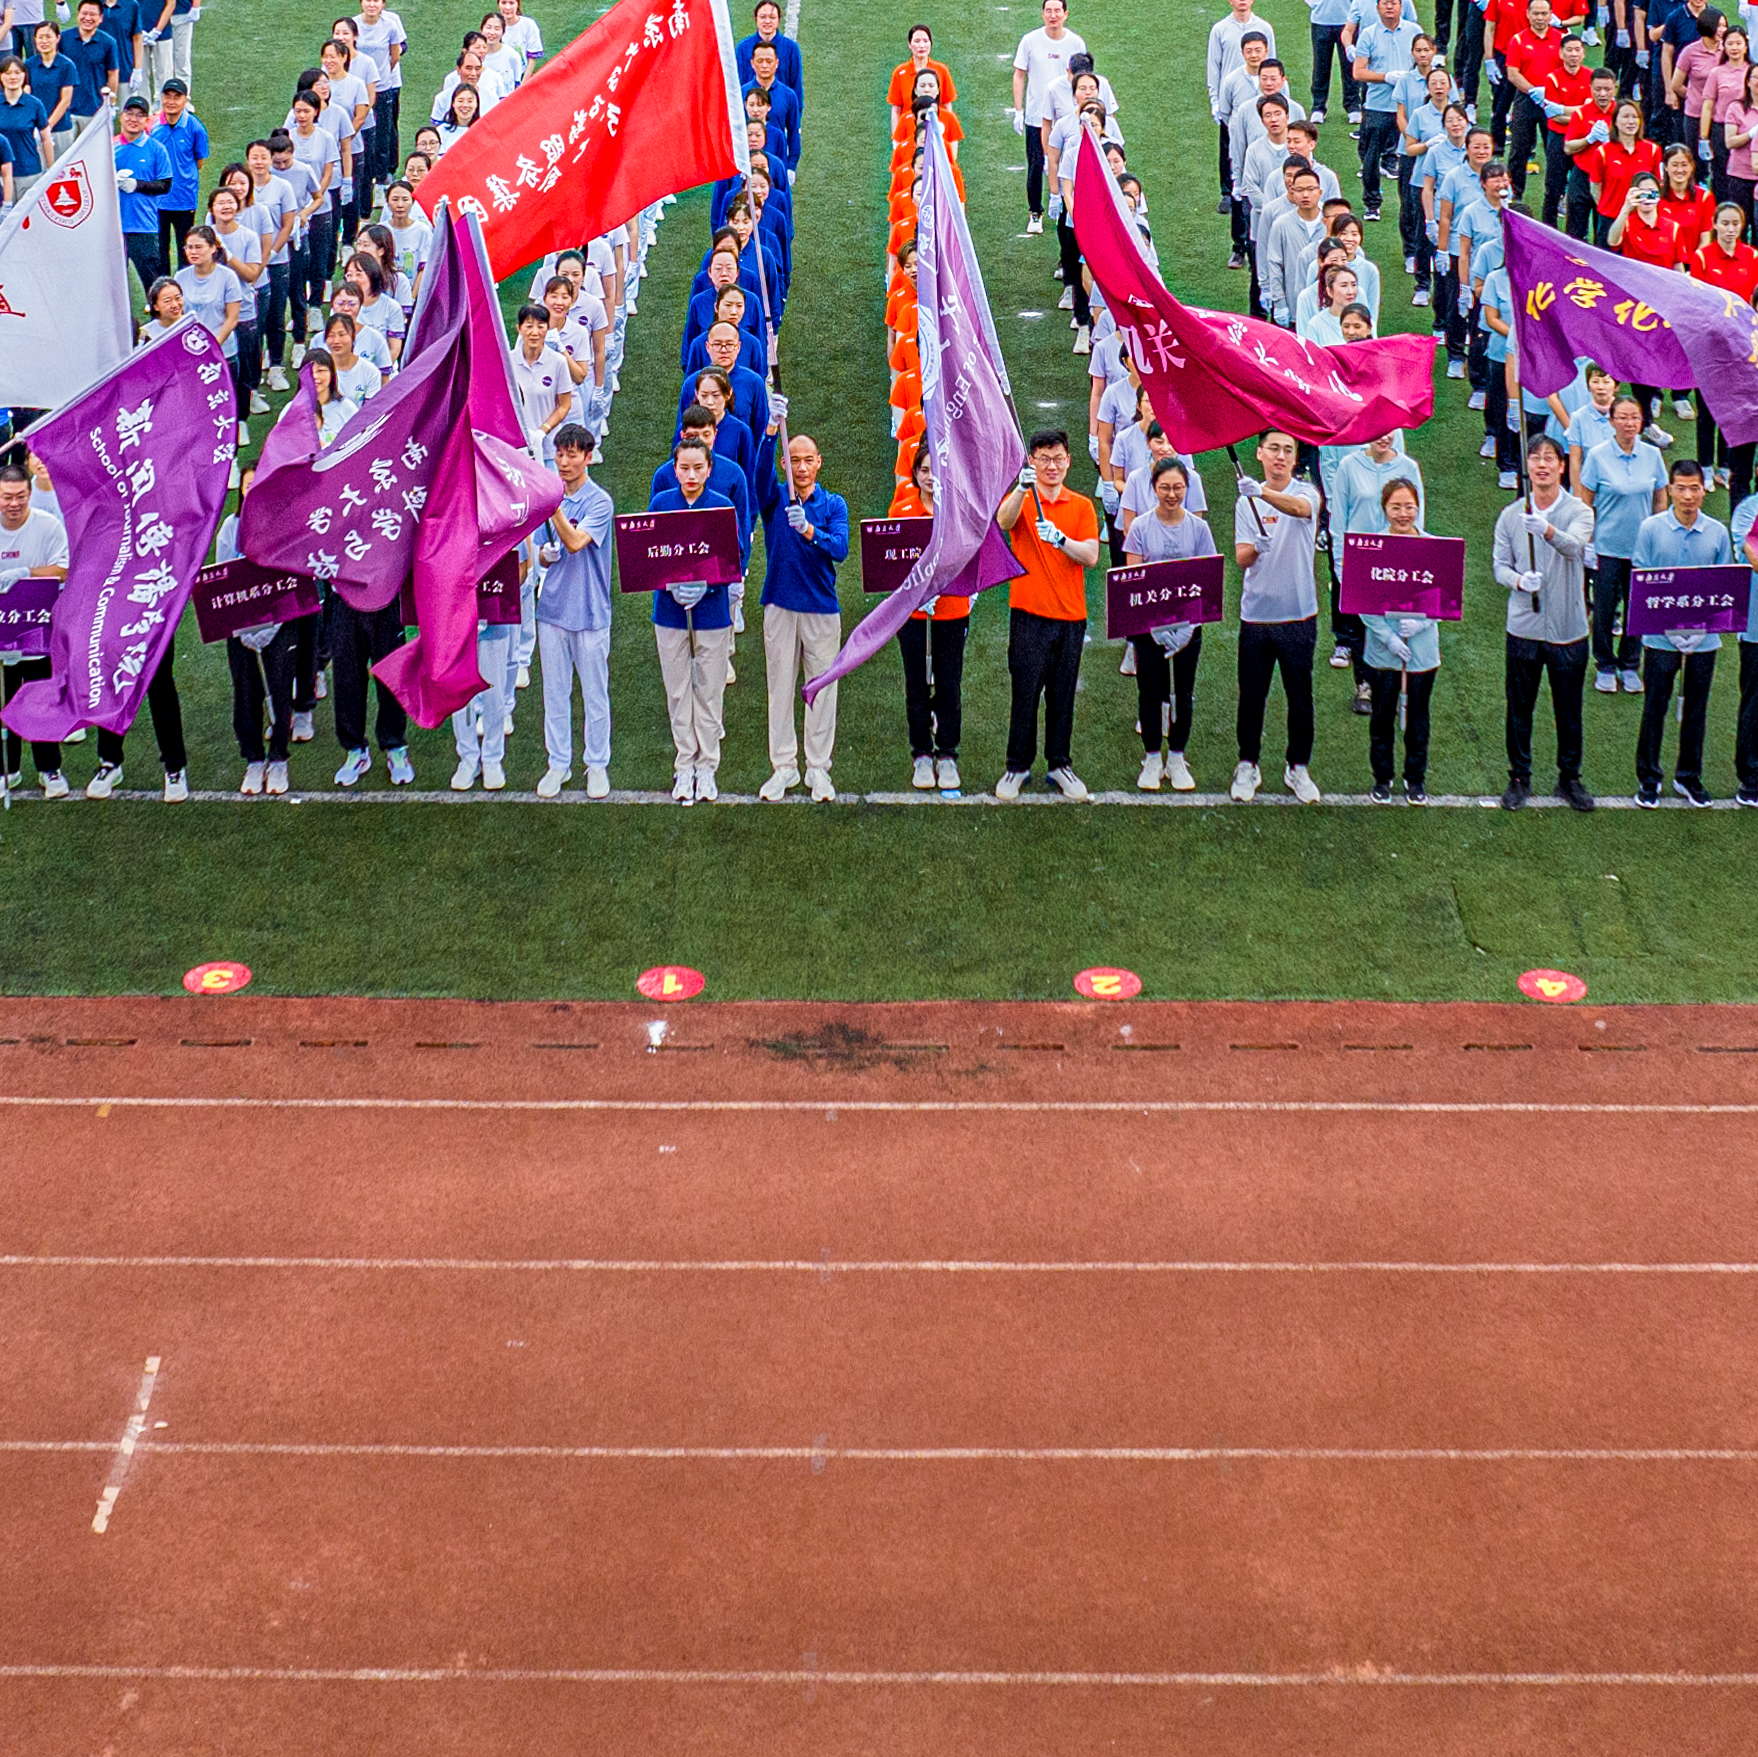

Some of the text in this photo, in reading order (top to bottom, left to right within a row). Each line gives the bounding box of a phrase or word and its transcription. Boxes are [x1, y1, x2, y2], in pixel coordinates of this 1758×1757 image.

[88, 587, 116, 710] Communication
[200, 969, 235, 990] 3
[662, 973, 685, 996] 1
[1091, 975, 1123, 996] 2
[1535, 978, 1569, 999] 4
